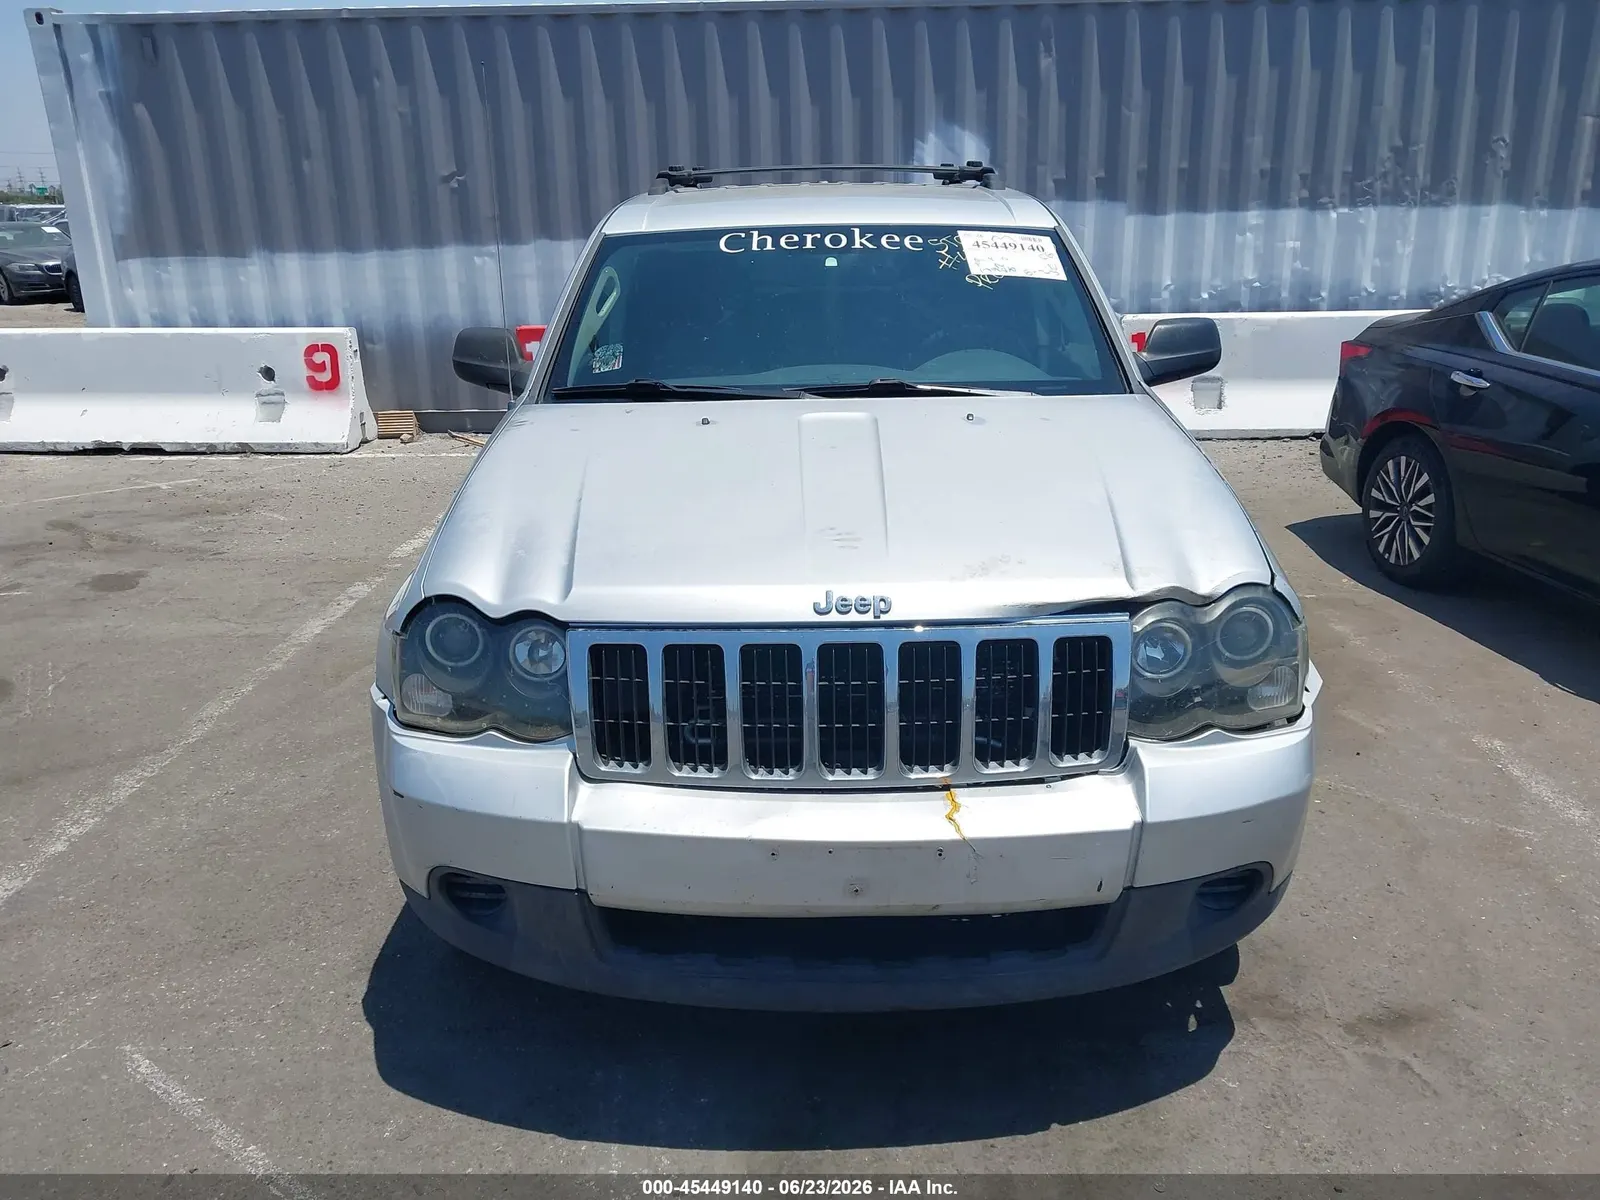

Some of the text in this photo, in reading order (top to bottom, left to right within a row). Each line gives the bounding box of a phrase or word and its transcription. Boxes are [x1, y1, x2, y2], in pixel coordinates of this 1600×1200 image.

[719, 227, 924, 253] Cherokee
[972, 240, 1045, 253] 45449140
[303, 343, 341, 391] 9
[813, 590, 892, 619] Jeep
